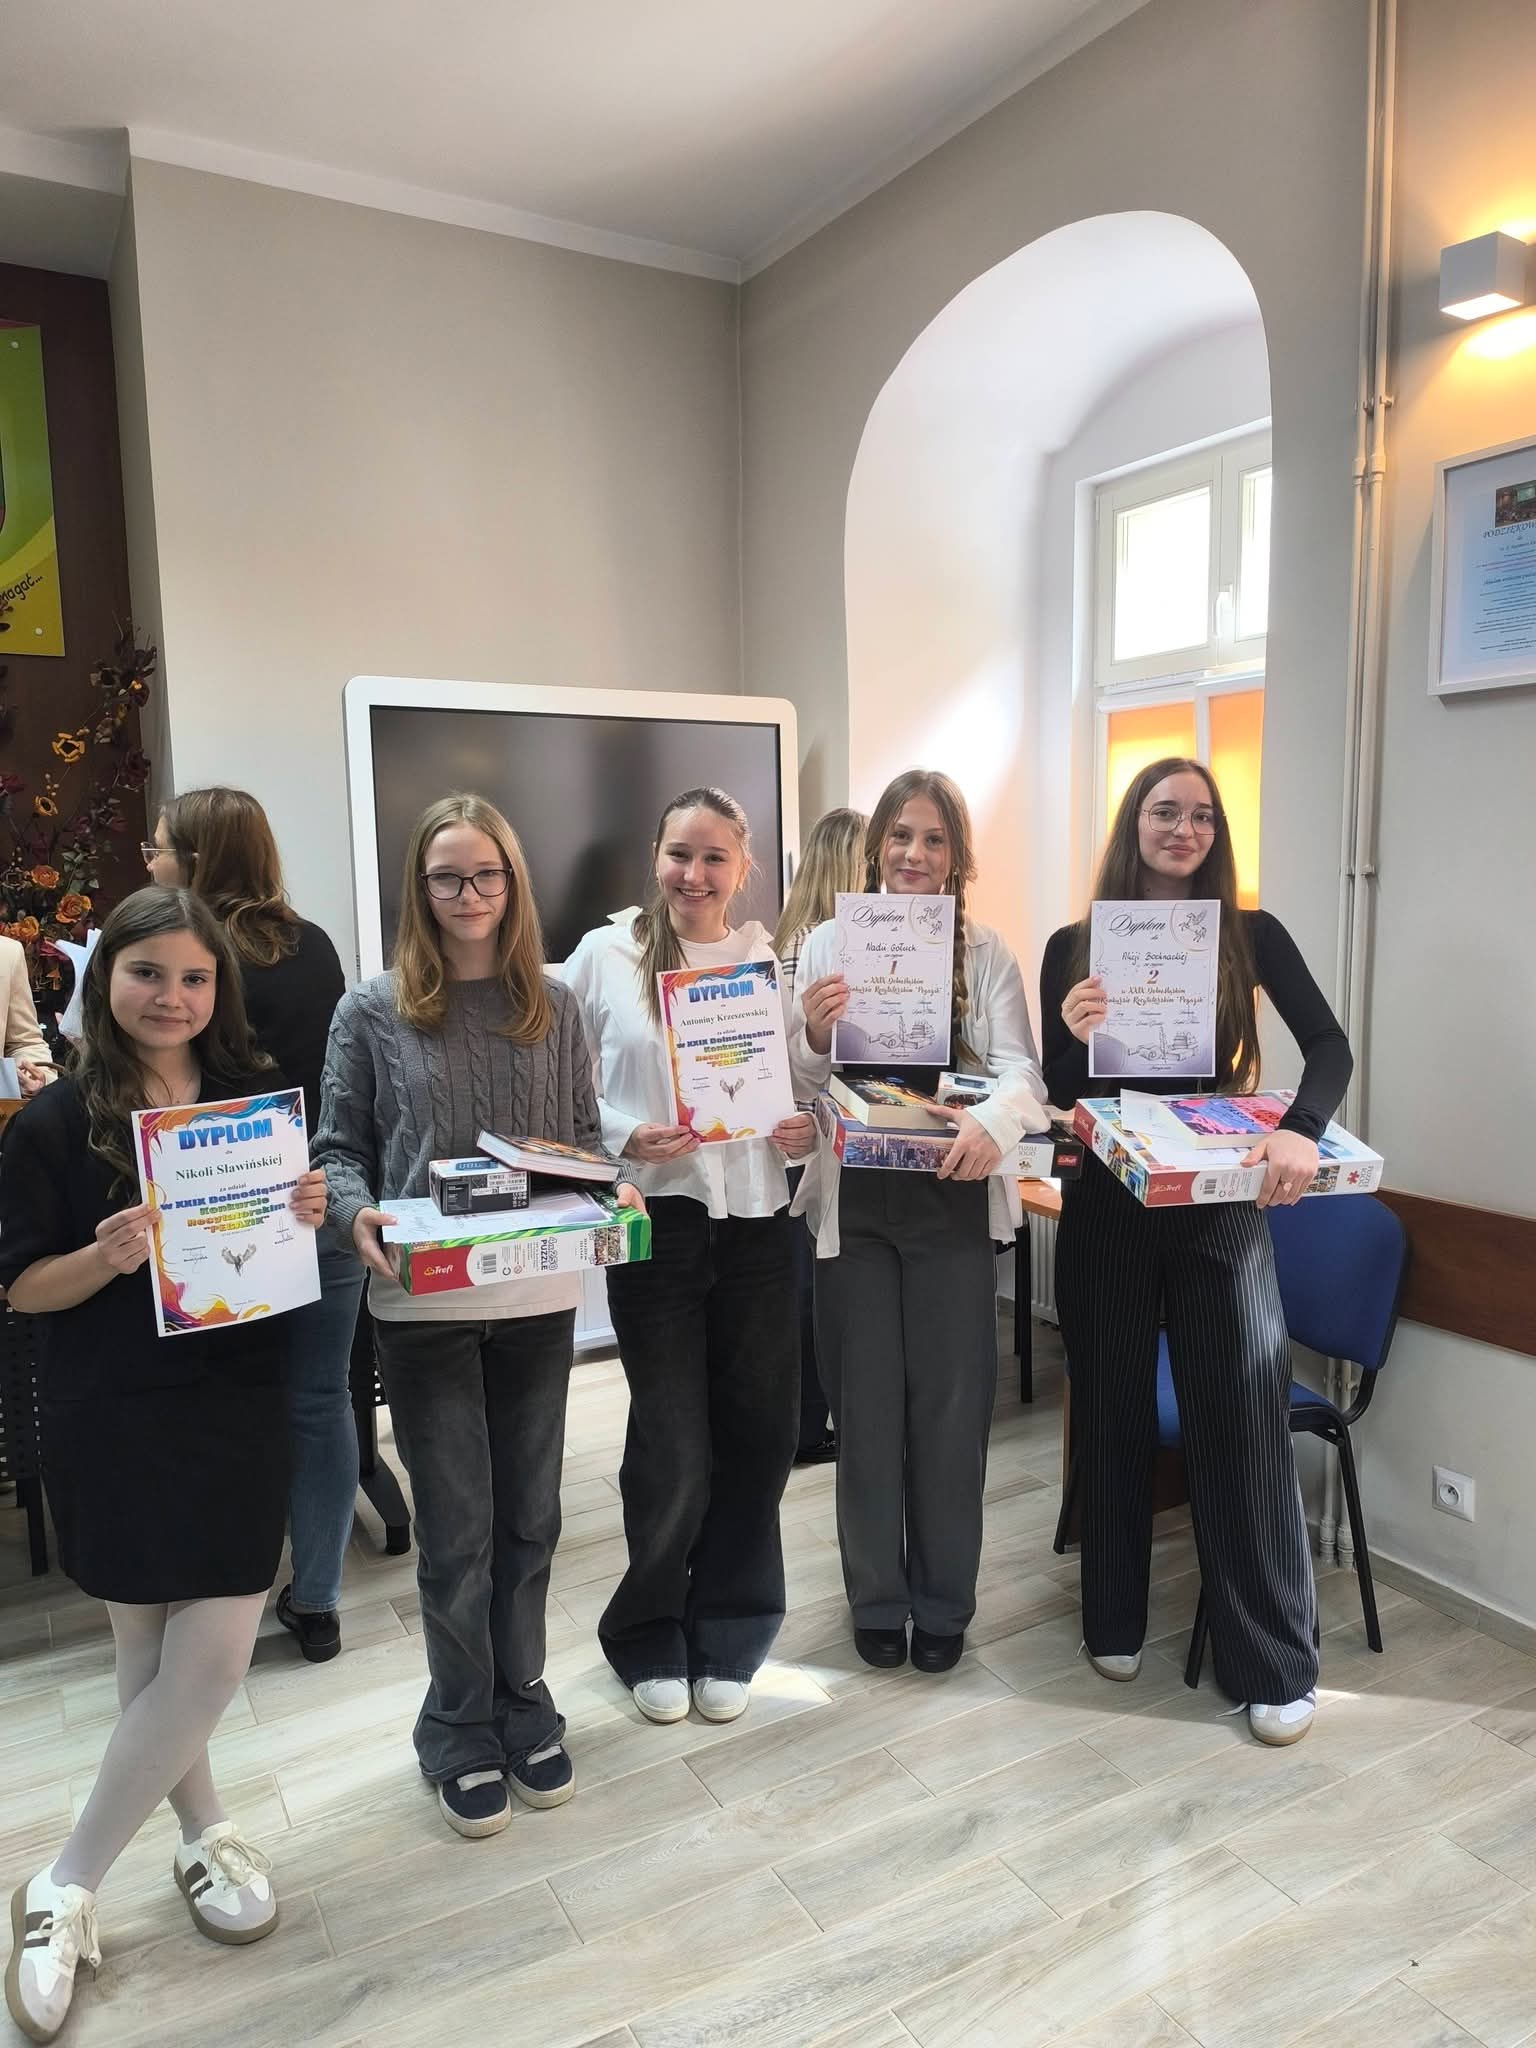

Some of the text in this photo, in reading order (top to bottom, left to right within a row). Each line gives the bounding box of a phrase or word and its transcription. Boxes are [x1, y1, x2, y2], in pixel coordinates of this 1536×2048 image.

[851, 906, 905, 928] Dyplom
[1108, 914, 1166, 937] Dyplom
[1146, 969, 1160, 984] 2
[688, 980, 754, 1003] DYPLOM
[680, 1016, 716, 1027] Antoniny
[687, 1038, 708, 1047] XXIX
[178, 1118, 273, 1150] DYPLOM
[176, 1153, 282, 1181] Nikoli Sławińskiej
[160, 1180, 298, 1211] w XXIX Dolnośląskim
[200, 1197, 270, 1215] Konkursie
[433, 1264, 455, 1275] Trefl
